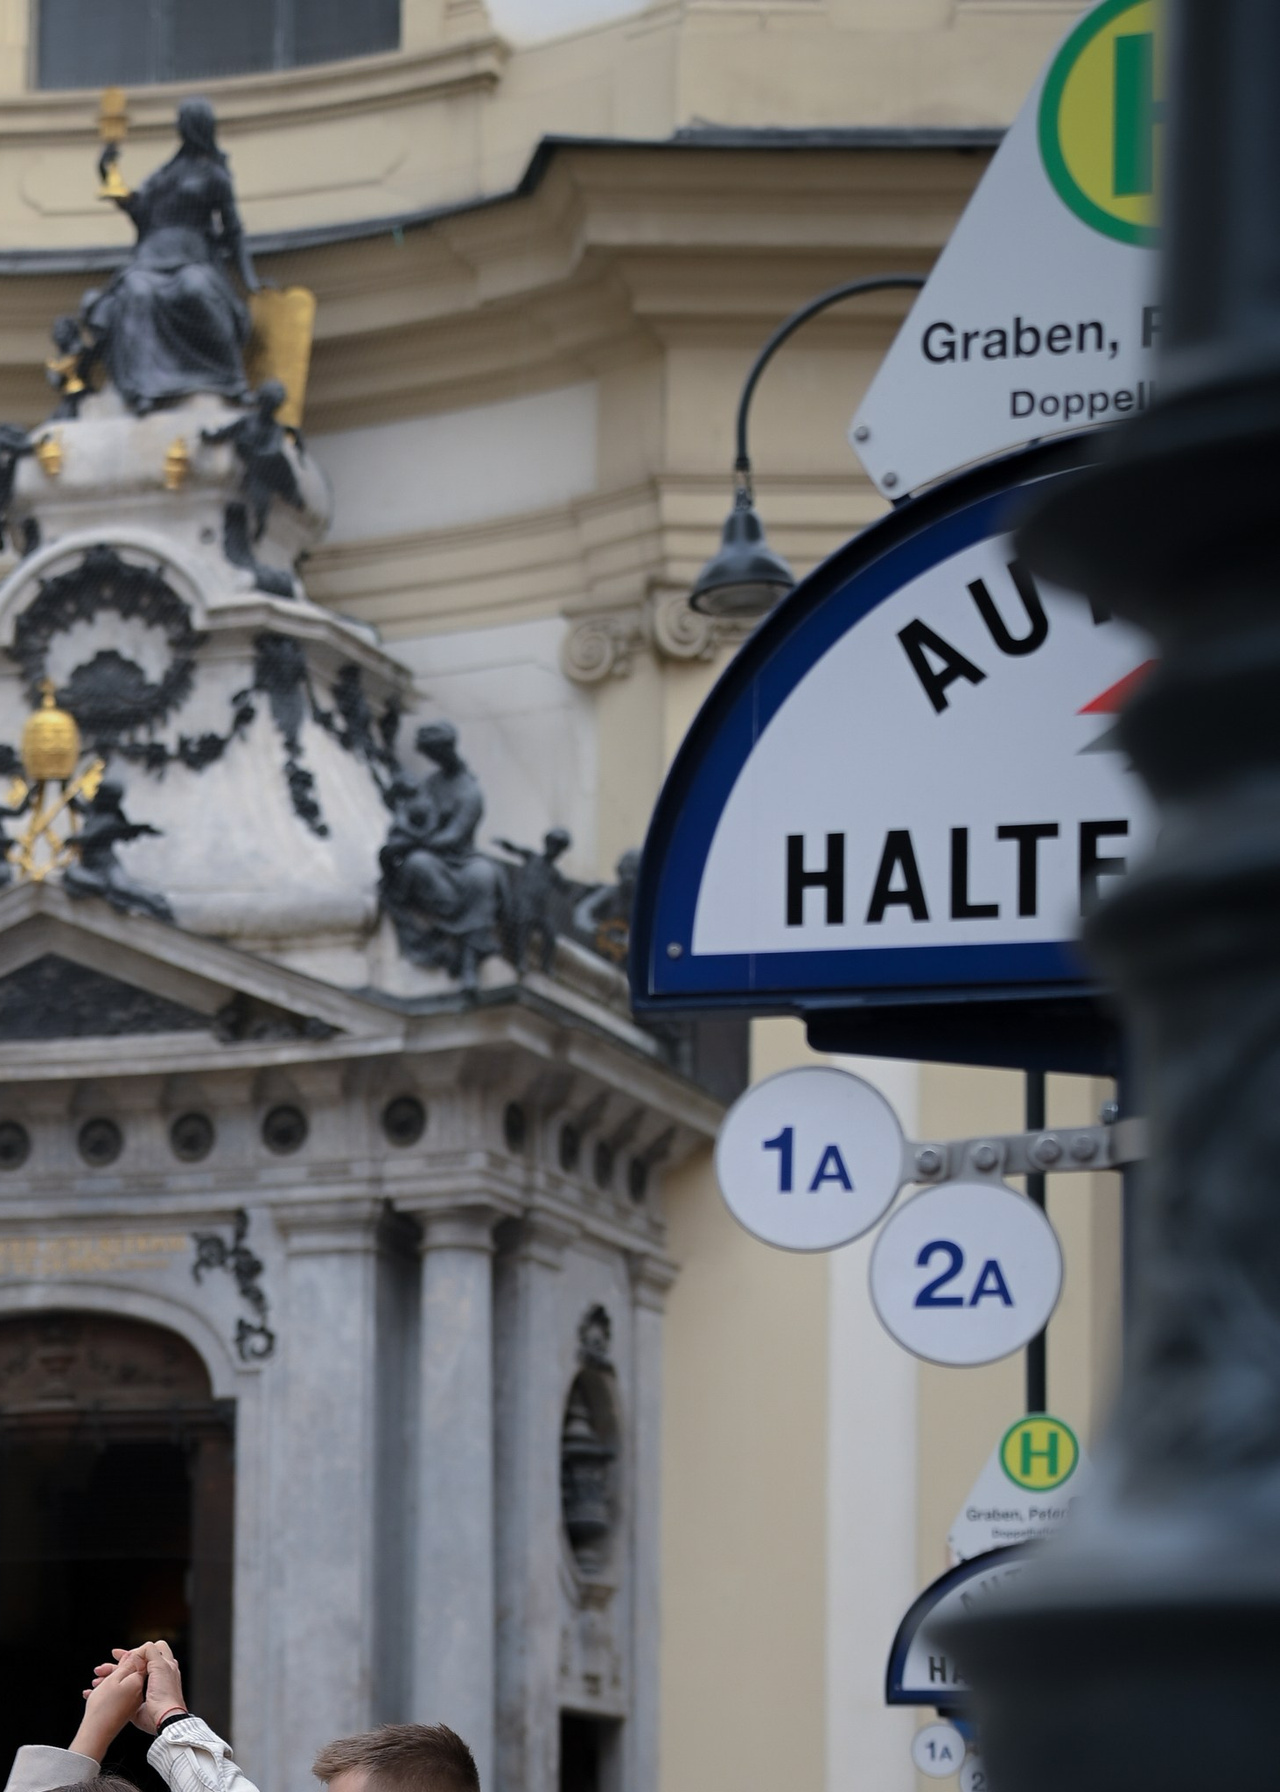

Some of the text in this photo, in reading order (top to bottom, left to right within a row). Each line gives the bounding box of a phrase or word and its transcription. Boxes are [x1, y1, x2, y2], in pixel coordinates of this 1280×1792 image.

[920, 316, 1120, 364] Graben,
[1010, 381, 1157, 422] Doppel
[896, 556, 1116, 714] AU
[761, 1125, 854, 1194] 1A
[912, 1239, 1015, 1309] 2A
[1019, 1430, 1060, 1477] H
[965, 1505, 1023, 1523] Graben,
[924, 1739, 953, 1763] 1A
